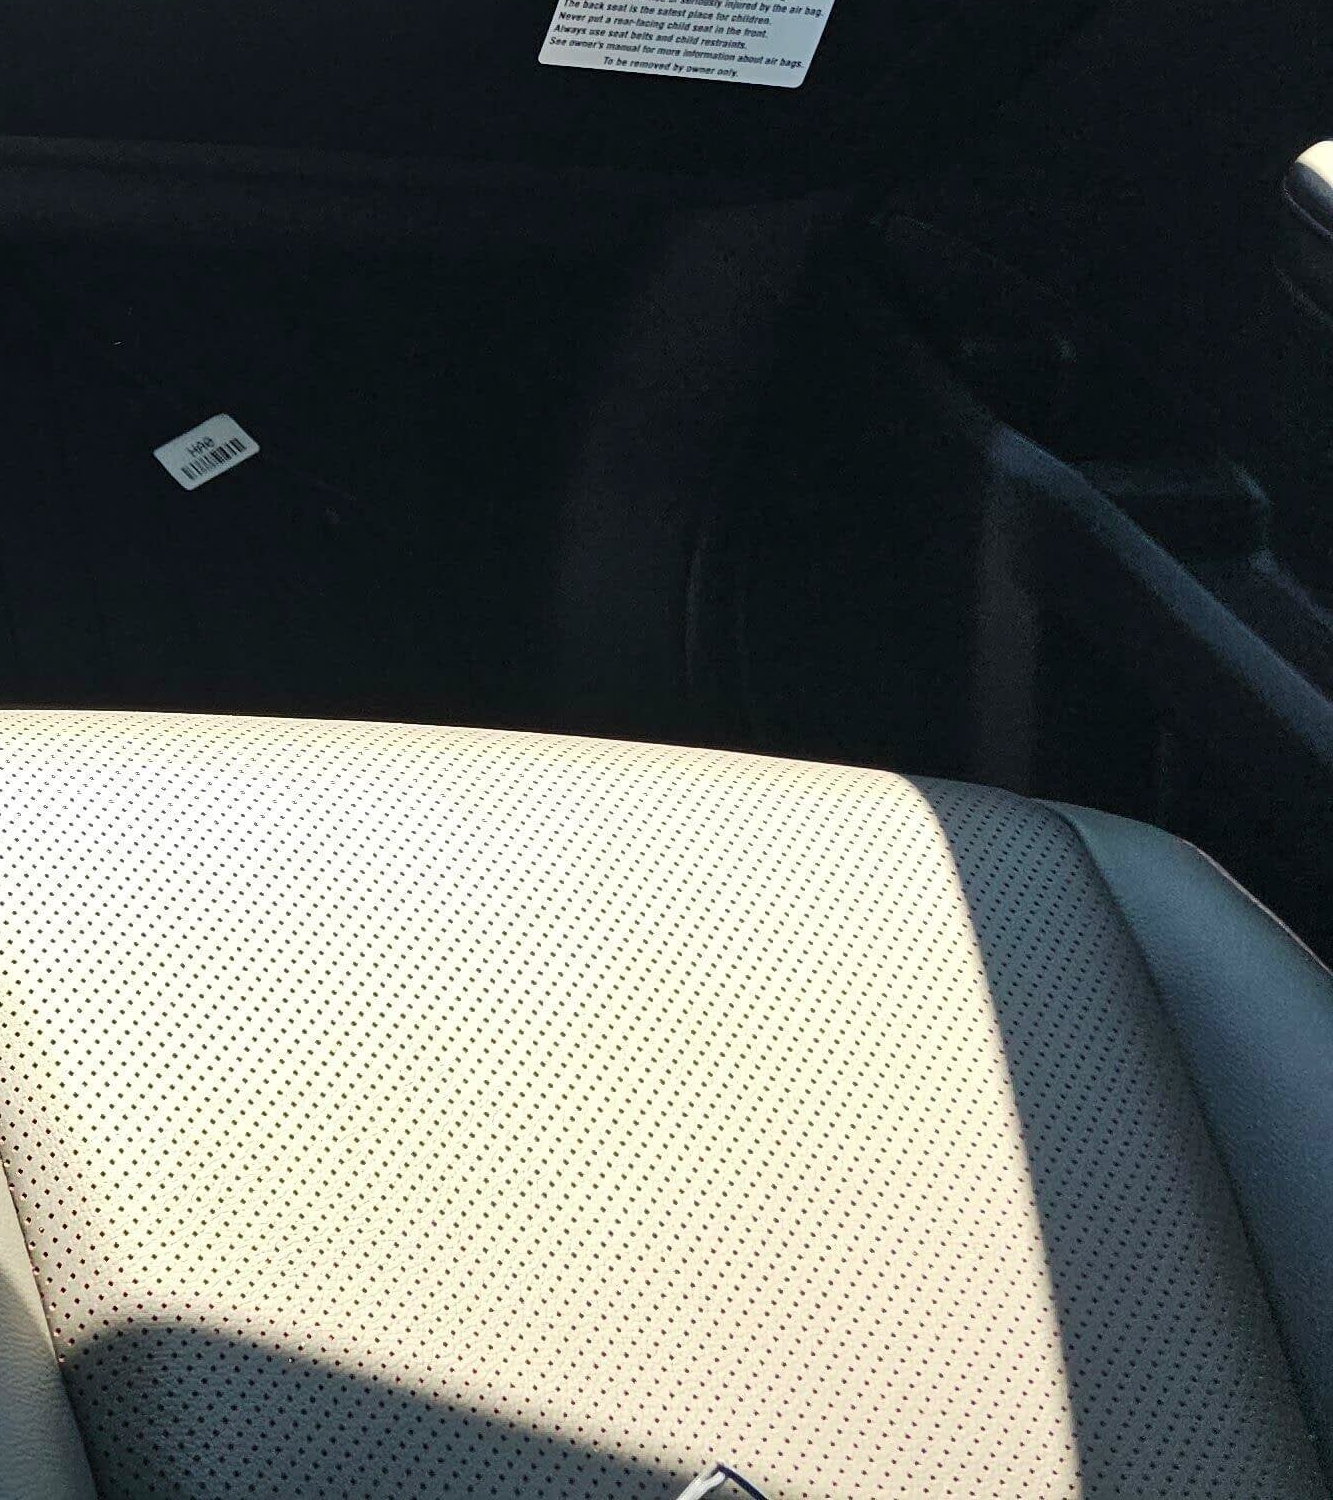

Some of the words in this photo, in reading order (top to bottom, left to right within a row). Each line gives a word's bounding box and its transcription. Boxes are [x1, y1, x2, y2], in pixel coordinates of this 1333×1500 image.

[563, 0, 581, 8] The
[582, 0, 604, 10] back
[606, 3, 628, 12] seat
[629, 4, 638, 13] is
[639, 5, 656, 15] the
[657, 7, 686, 17] safest
[687, 9, 713, 20] place
[716, 12, 730, 21] for
[731, 14, 772, 25] children.
[724, 0, 757, 11] injured
[759, 2, 771, 12] by
[772, 3, 788, 13] the
[788, 5, 803, 15] air
[804, 6, 824, 18] bag.
[553, 24, 587, 36] Always
[589, 28, 606, 37] use
[608, 30, 629, 38] seat
[630, 31, 653, 41] belts
[655, 34, 674, 43] and
[675, 36, 700, 45] child
[700, 38, 748, 50] restraints.
[558, 12, 586, 21] Never
[587, 14, 603, 23] put
[613, 17, 665, 30] rear-facing
[667, 21, 691, 31] child
[693, 24, 714, 33] seat
[714, 25, 725, 34] in
[726, 26, 742, 36] the
[743, 28, 769, 39] front.
[603, 56, 614, 65] To
[616, 58, 628, 67] be
[629, 60, 671, 71] removed
[672, 63, 684, 73] by
[686, 66, 715, 74] owner
[717, 67, 738, 78] only.
